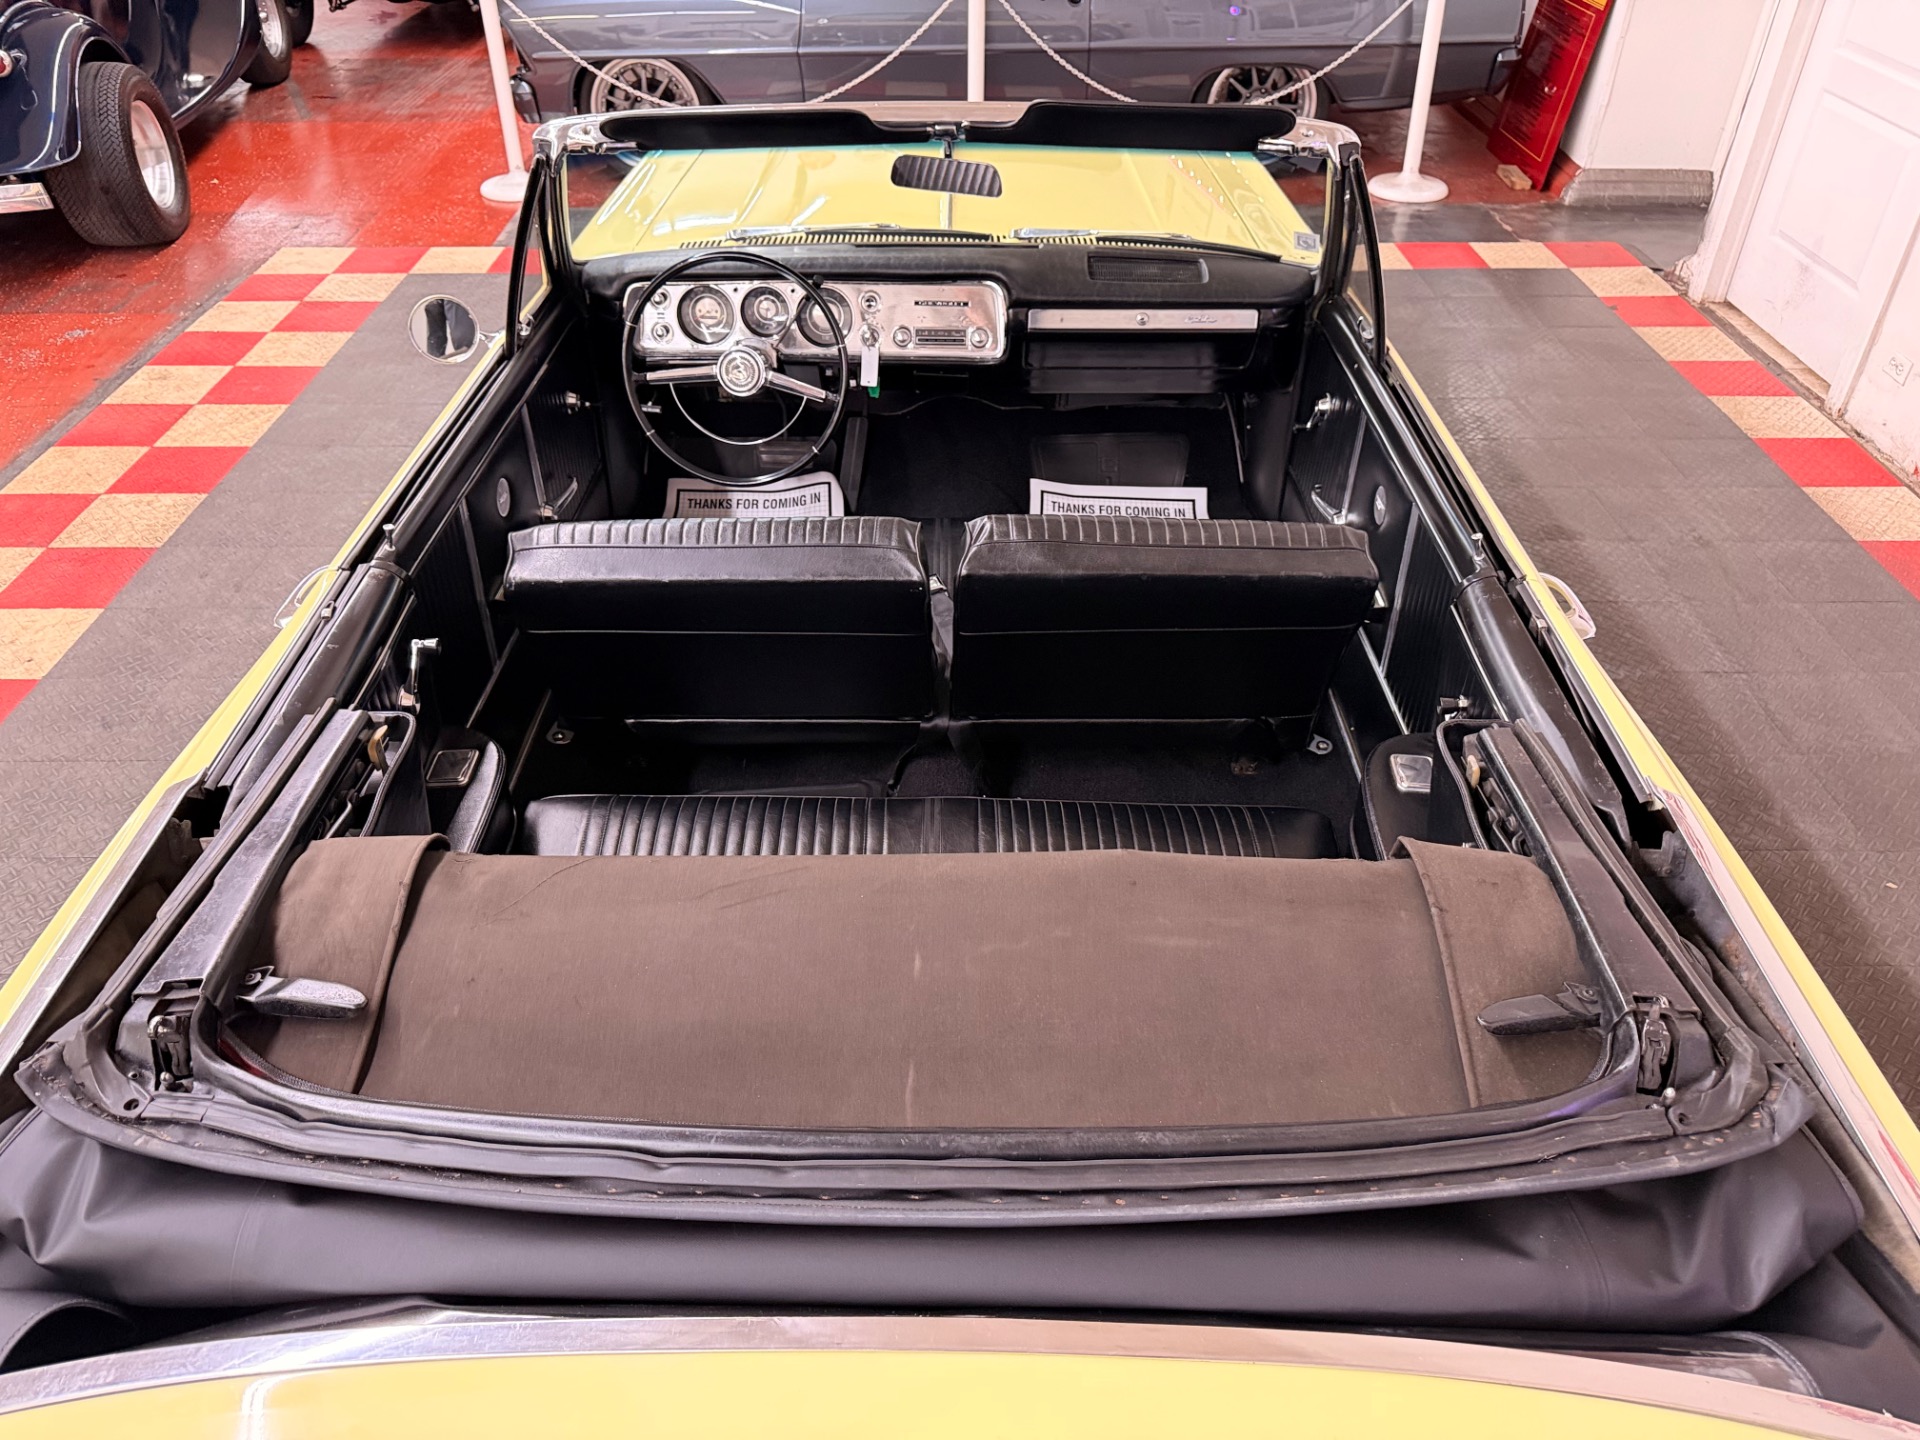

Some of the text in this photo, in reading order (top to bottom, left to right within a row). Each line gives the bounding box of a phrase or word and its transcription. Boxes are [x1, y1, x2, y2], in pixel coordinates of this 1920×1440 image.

[687, 492, 821, 510] THANKS FOR COMING IN
[1051, 500, 1186, 518] THANKS FOR COMING IN
